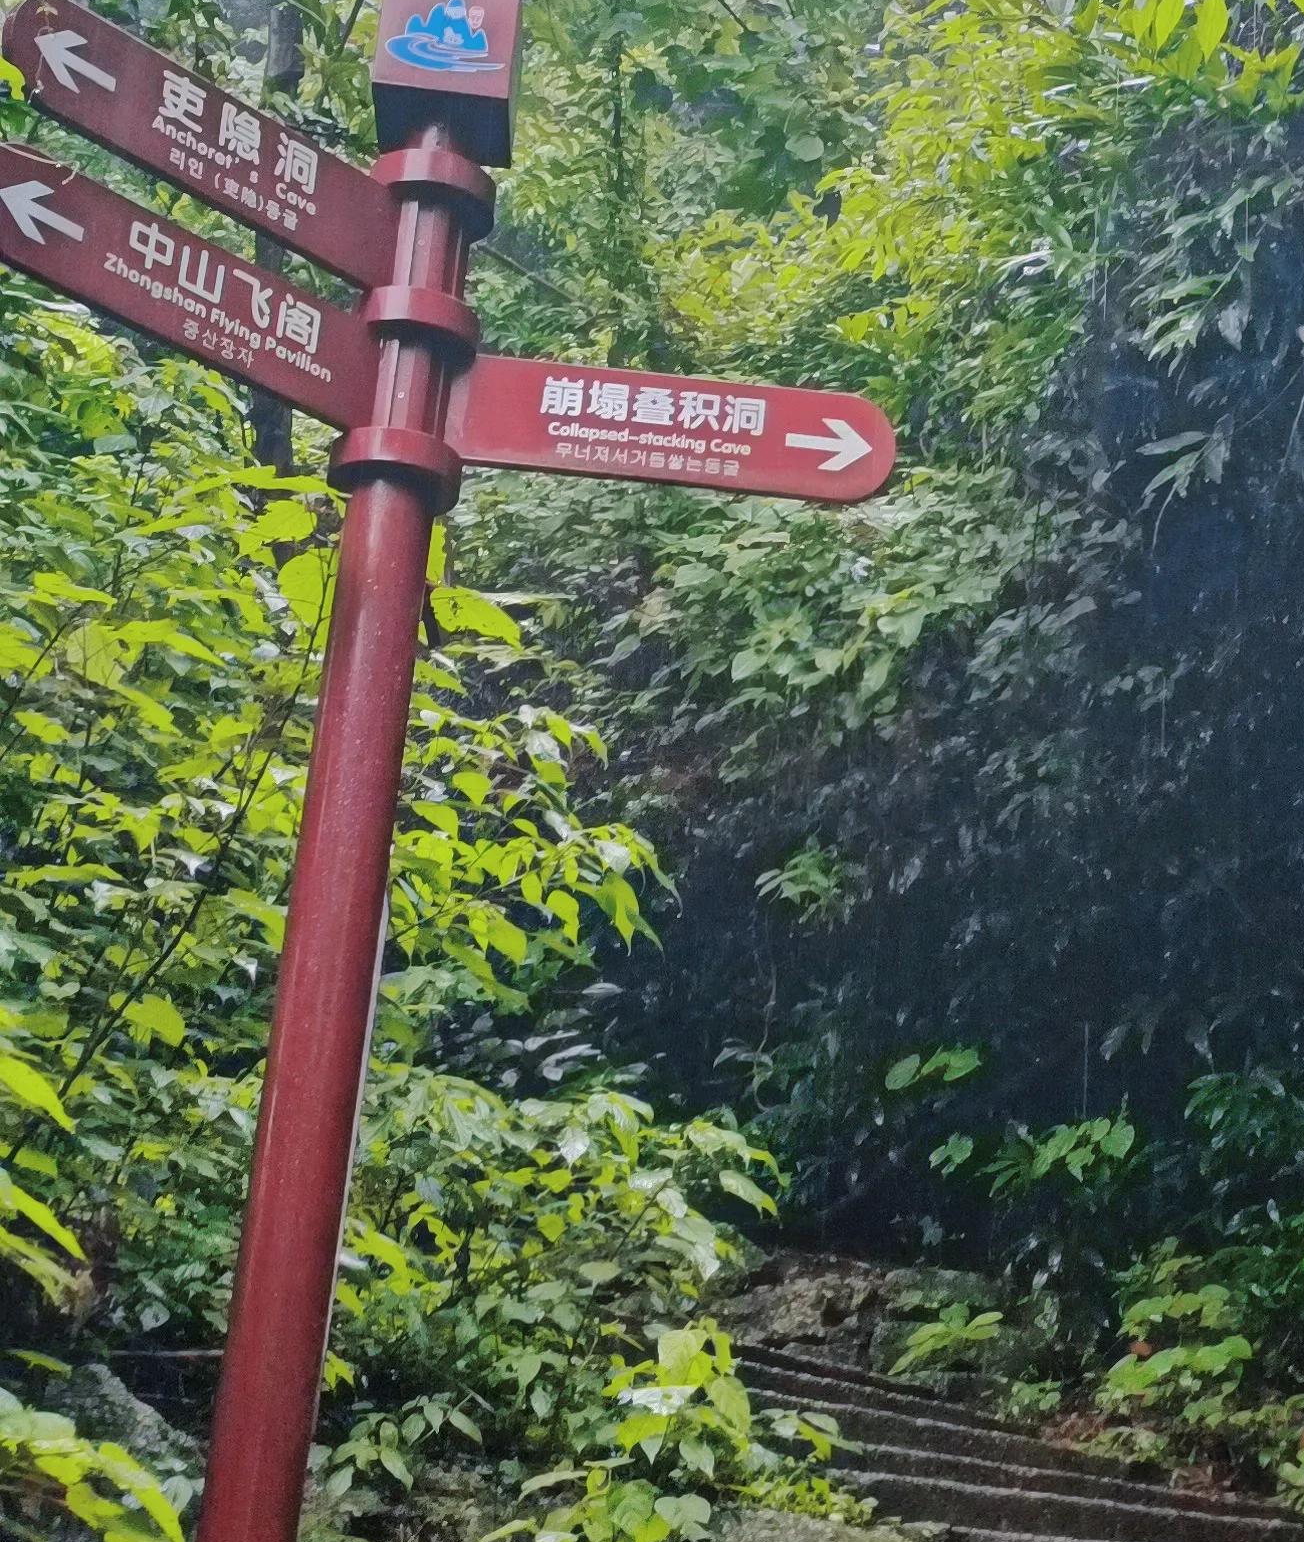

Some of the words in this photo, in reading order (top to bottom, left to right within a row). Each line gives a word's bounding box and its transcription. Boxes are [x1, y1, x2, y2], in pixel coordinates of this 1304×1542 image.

[158, 69, 318, 195] 吏隐洞
[275, 182, 317, 216] Cave
[103, 252, 207, 320] Zhongshan
[210, 307, 261, 350] Flying
[265, 335, 332, 384] Pavilion
[128, 220, 321, 355] 中山飞阁
[539, 375, 767, 437] 崩塌叠积洞
[547, 421, 707, 454] Collapsed-stacking
[710, 438, 752, 456] Cave
